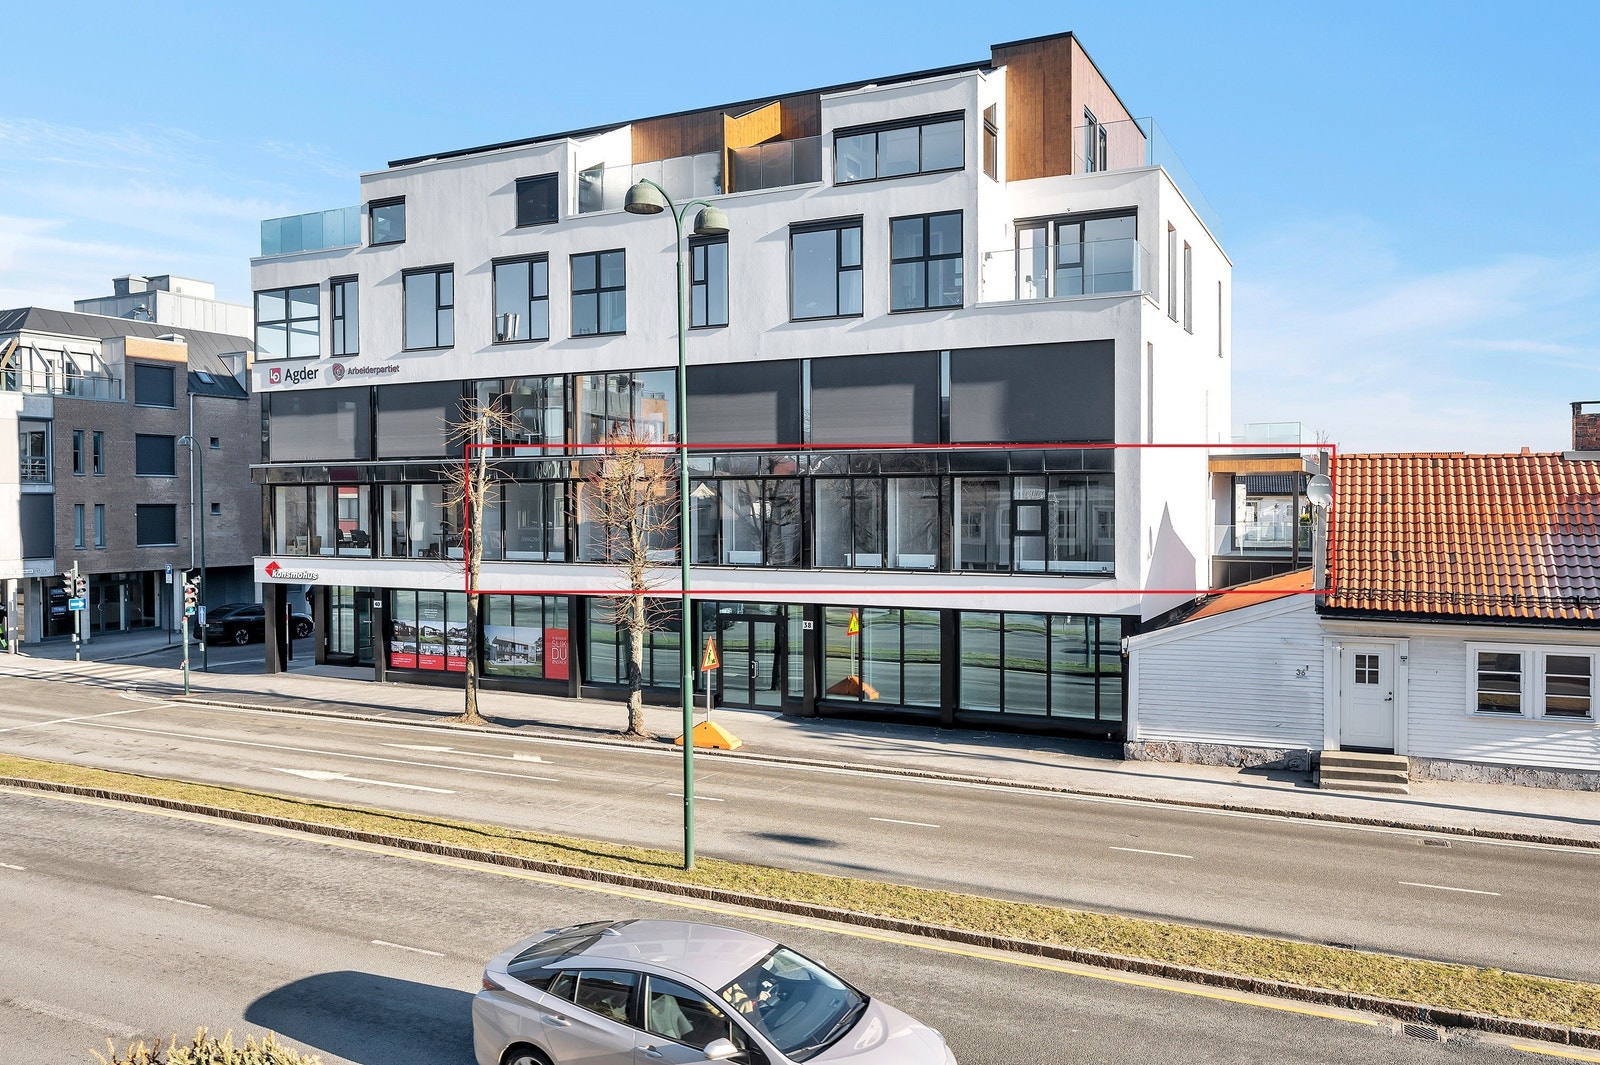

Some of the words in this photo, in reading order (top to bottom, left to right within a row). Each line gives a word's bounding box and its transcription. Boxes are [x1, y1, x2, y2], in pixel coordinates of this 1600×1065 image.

[285, 367, 319, 384] Agder
[348, 364, 400, 375] Arbeiderpartiet
[272, 569, 319, 580] konsmohus
[551, 647, 567, 661] DU
